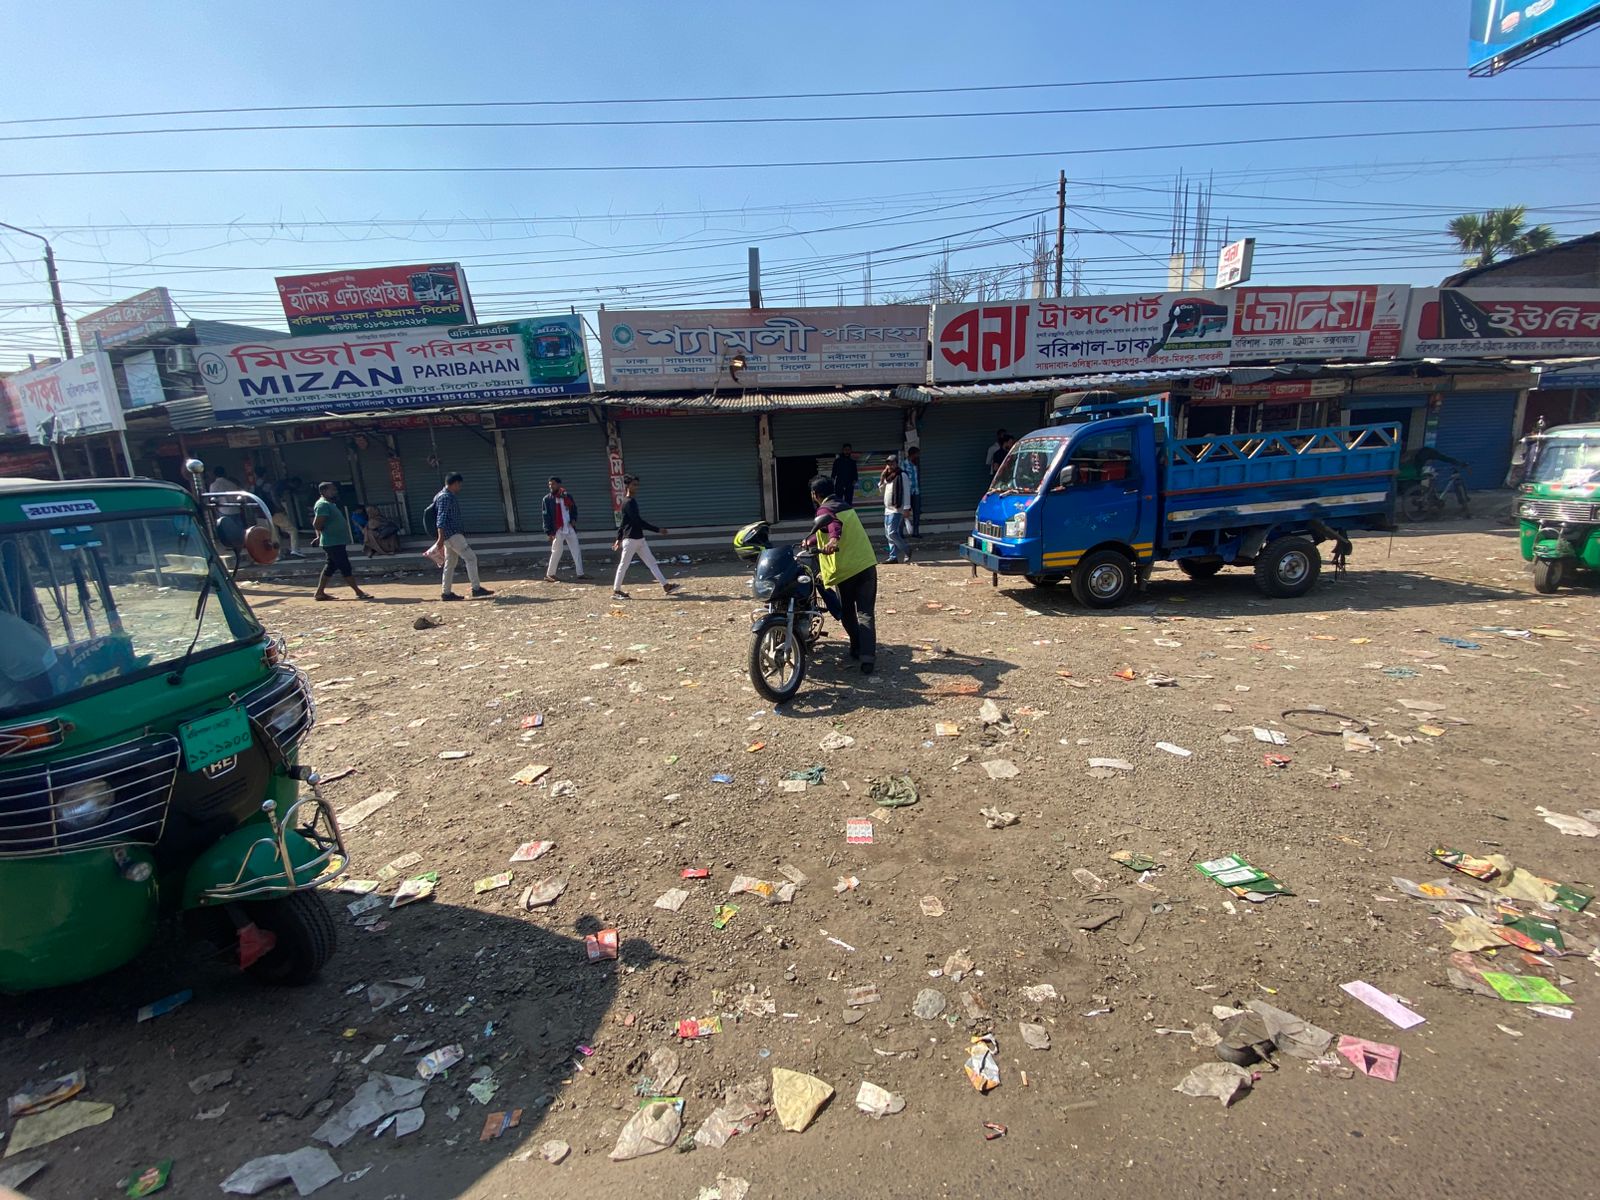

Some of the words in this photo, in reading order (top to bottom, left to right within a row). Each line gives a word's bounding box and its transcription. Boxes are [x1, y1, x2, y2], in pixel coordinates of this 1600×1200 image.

[287, 284, 330, 312] হানিফ
[334, 280, 410, 308] এন্টারপ্রাইজ
[1037, 294, 1164, 330] ট্রান্সপোর্ট
[638, 316, 818, 355] শ্যামলী
[821, 322, 927, 343] পরিবহন
[940, 304, 1030, 373] এনা
[1037, 337, 1158, 358] বরিশাল-ঢাকা
[229, 340, 402, 374] মিজান
[406, 338, 516, 359] পরিবহন
[238, 365, 404, 397] MIZAN
[412, 358, 521, 380] PARIBAHAN
[28, 502, 96, 516] RUNNER
